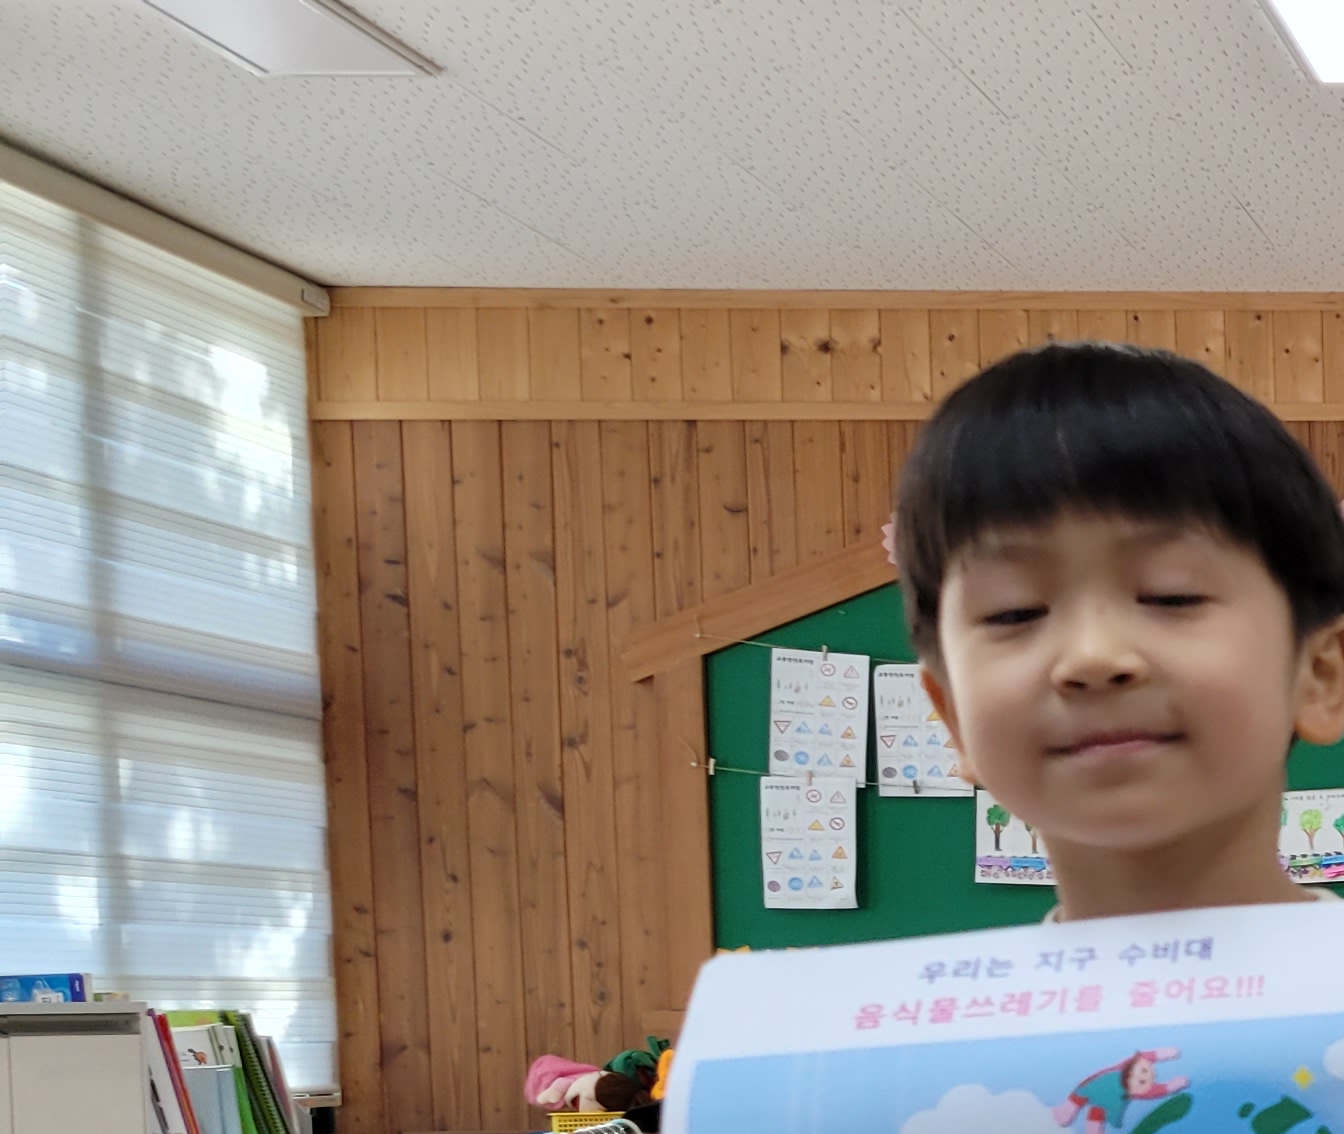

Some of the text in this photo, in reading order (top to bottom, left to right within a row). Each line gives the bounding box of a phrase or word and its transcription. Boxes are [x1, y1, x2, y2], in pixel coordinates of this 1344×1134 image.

[919, 935, 1215, 984] 우리는 지구 수비대
[853, 974, 1267, 1031] 음식물쓰레기를 줄어요!!!
